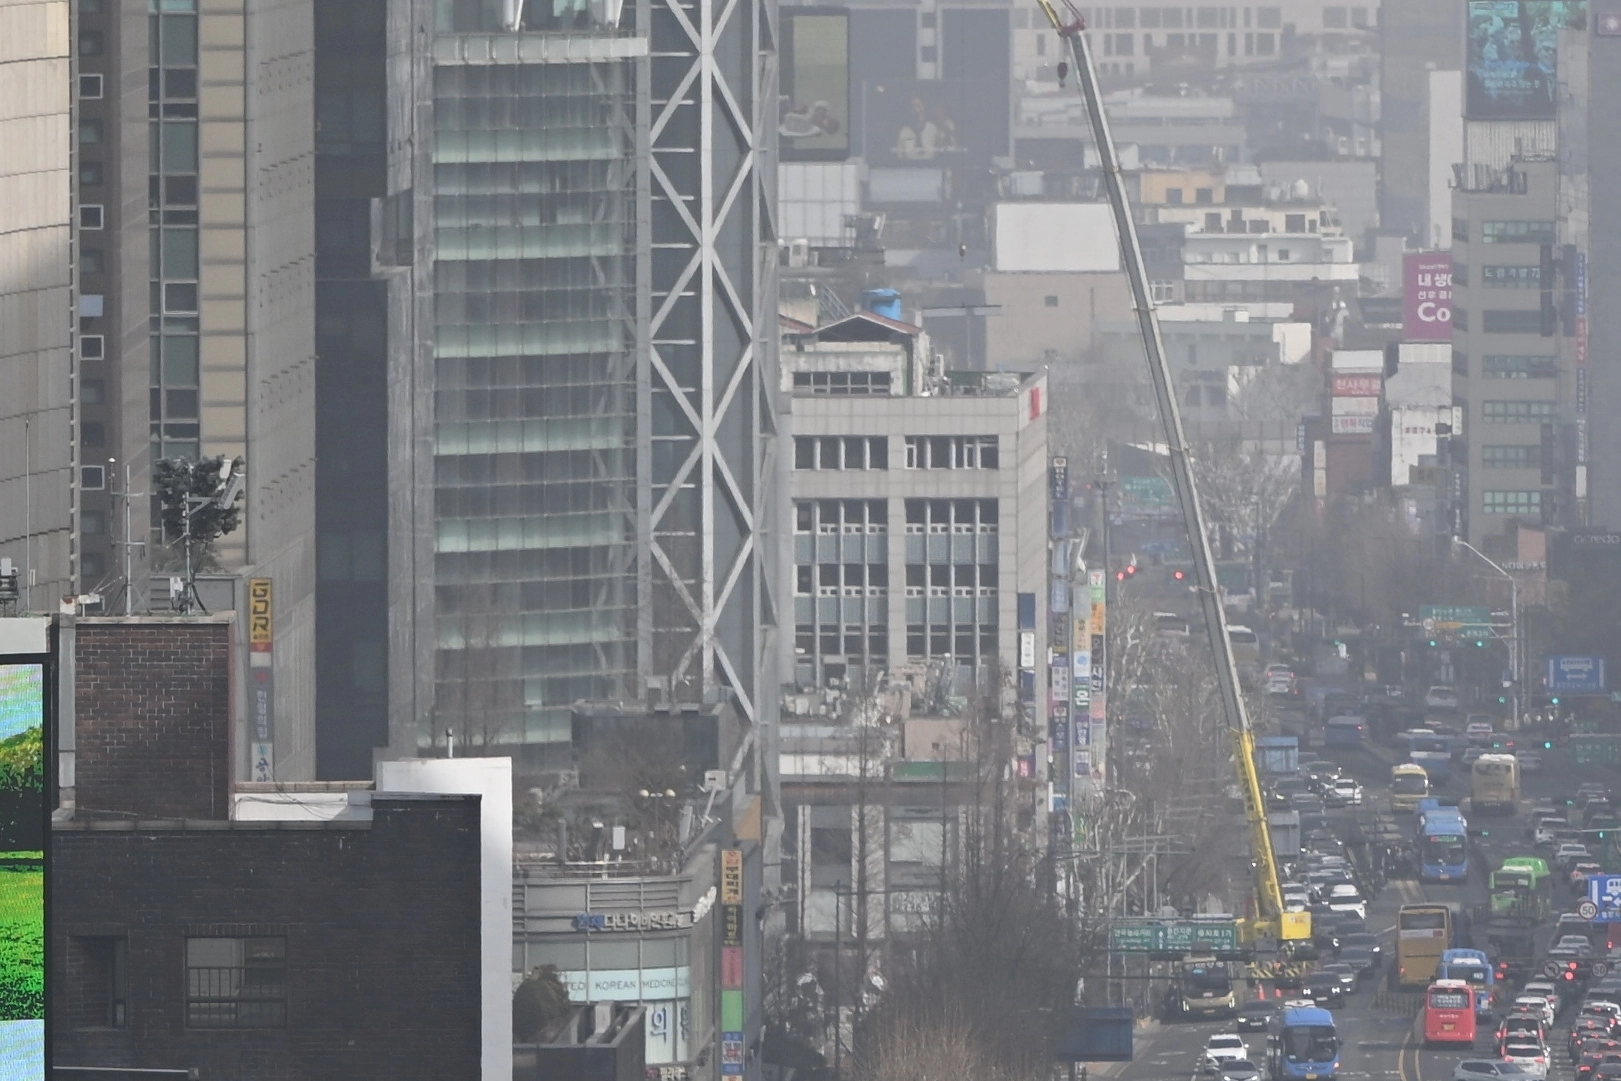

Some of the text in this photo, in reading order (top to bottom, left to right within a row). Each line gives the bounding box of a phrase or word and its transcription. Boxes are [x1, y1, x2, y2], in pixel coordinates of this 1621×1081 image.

[253, 582, 269, 632] GDR
[1582, 906, 1595, 916] 50
[595, 980, 637, 991] KOREAN
